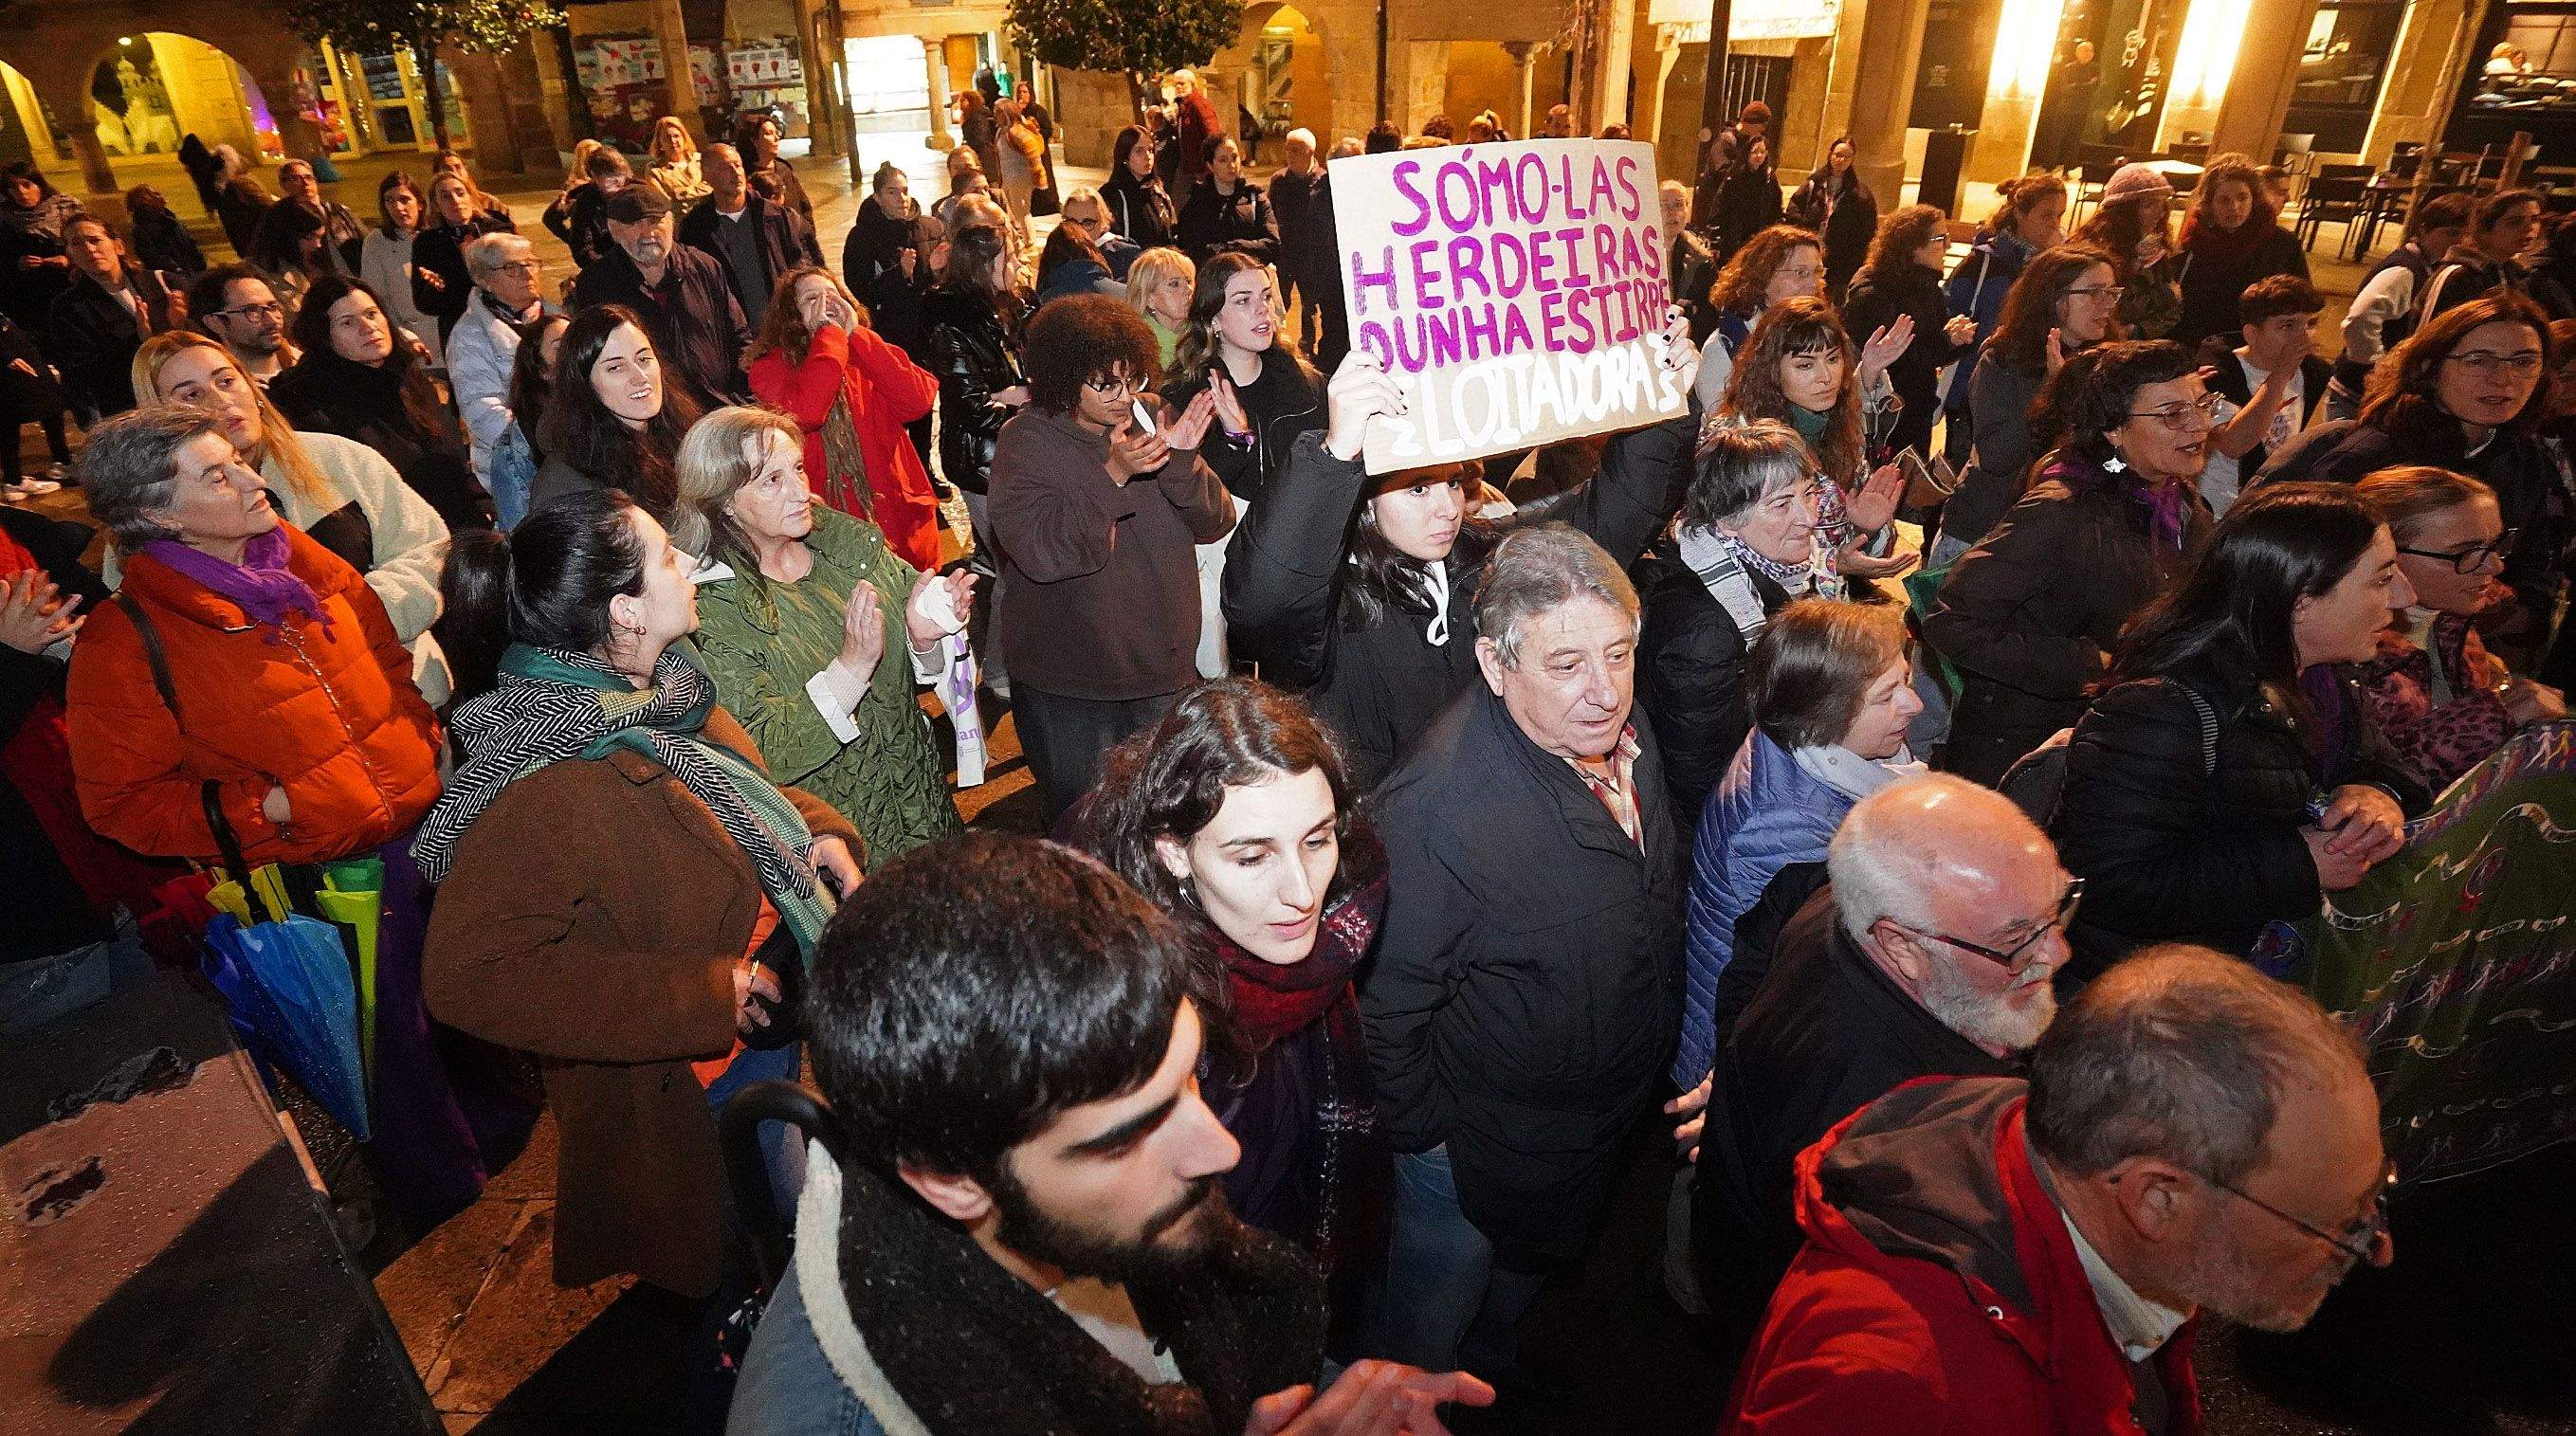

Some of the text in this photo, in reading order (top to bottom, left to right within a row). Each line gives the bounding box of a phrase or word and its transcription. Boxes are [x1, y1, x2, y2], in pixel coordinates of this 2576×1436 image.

[1391, 148, 1641, 237] SÓMO-LAS
[1352, 224, 1661, 316] HERDEIRAS
[1360, 278, 1671, 374] DUNHA ESTIRPE
